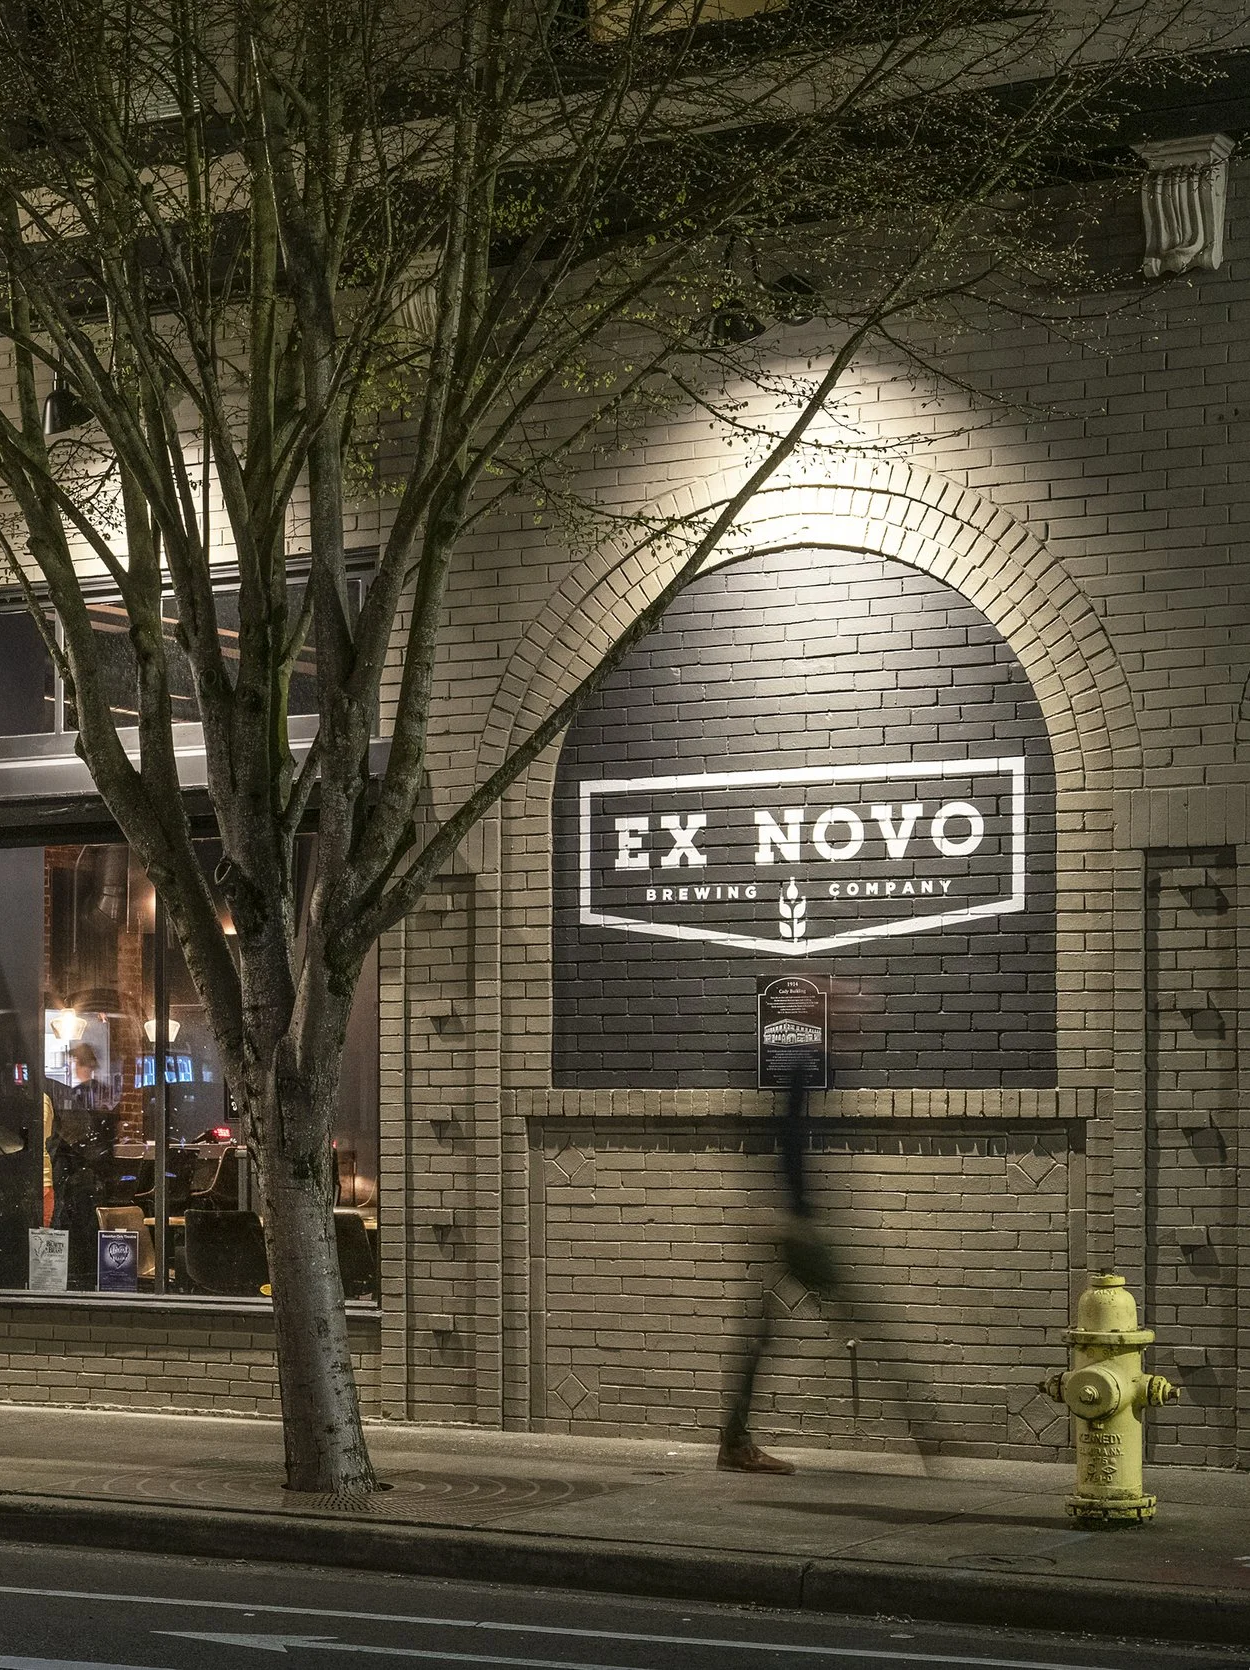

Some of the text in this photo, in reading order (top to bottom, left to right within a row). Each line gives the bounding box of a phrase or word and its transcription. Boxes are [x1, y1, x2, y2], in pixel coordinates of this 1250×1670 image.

[614, 801, 985, 872] EX NOVO
[646, 880, 952, 902] BREWING COMPANY
[1079, 1433, 1124, 1445] KENNEDY
